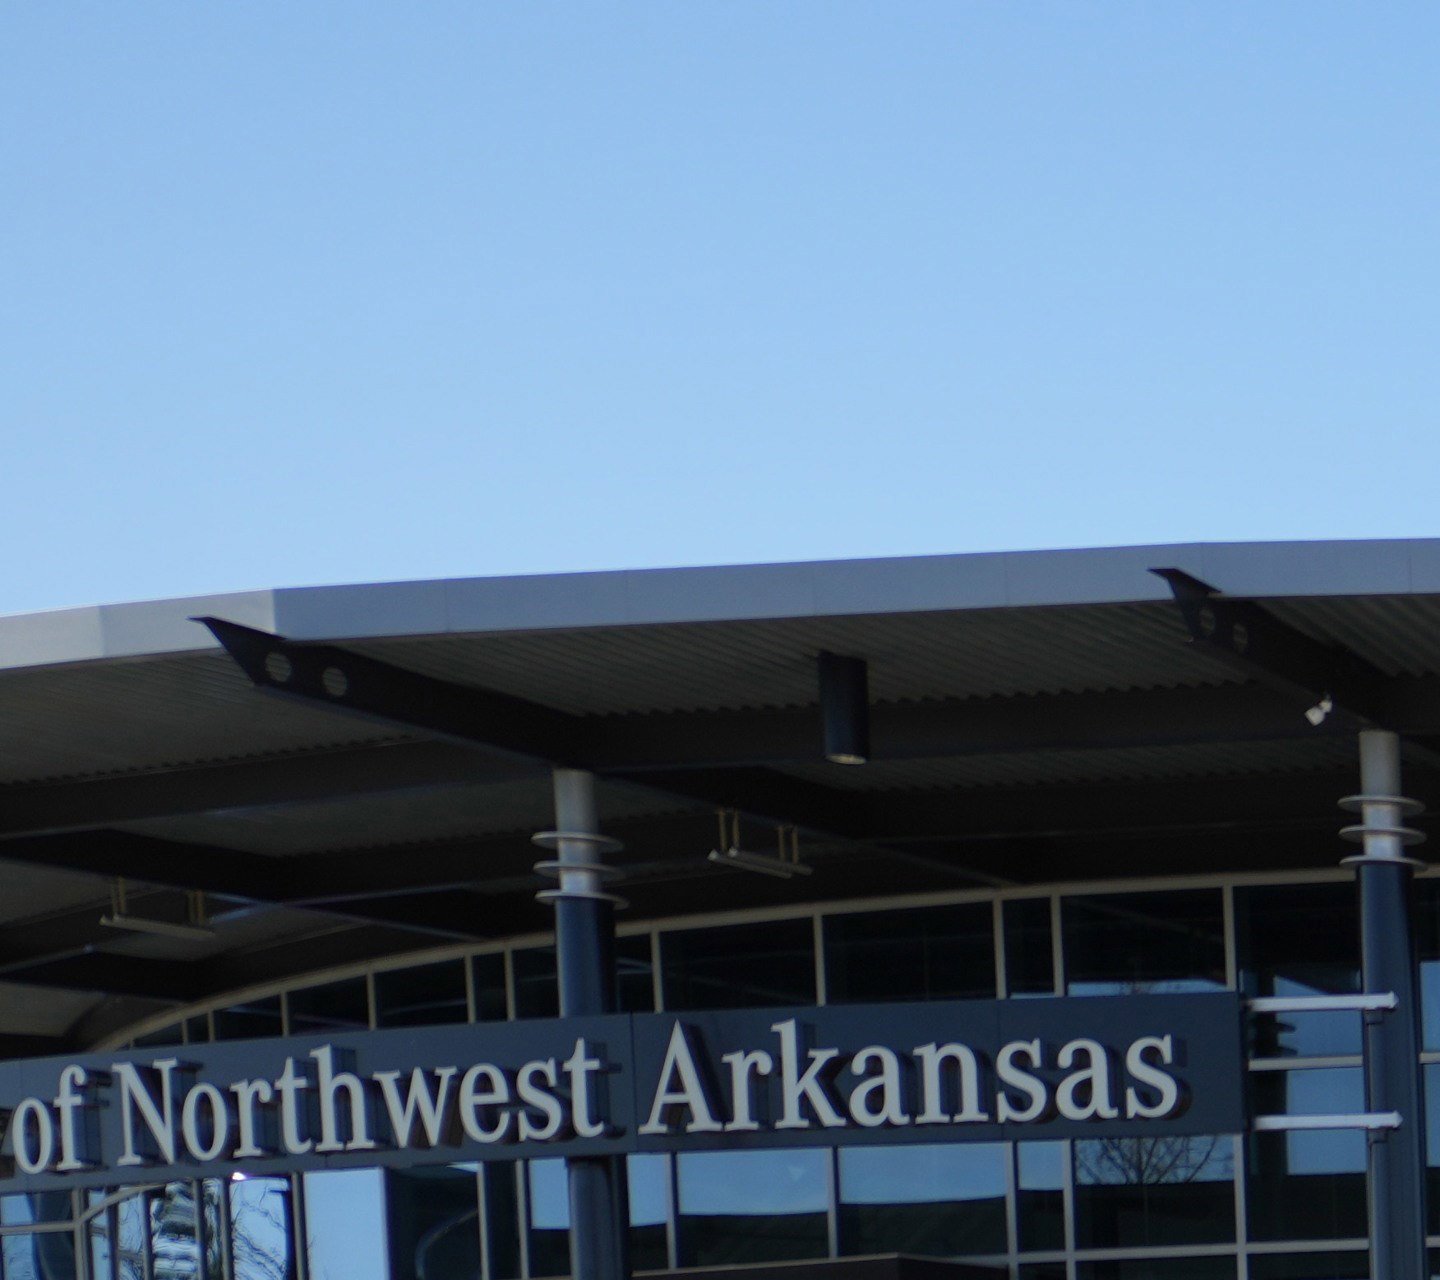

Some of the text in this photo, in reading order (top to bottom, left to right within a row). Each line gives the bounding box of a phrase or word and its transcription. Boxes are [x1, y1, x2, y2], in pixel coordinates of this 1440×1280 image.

[12, 1018, 1180, 1175] of Northwest Arkansas
